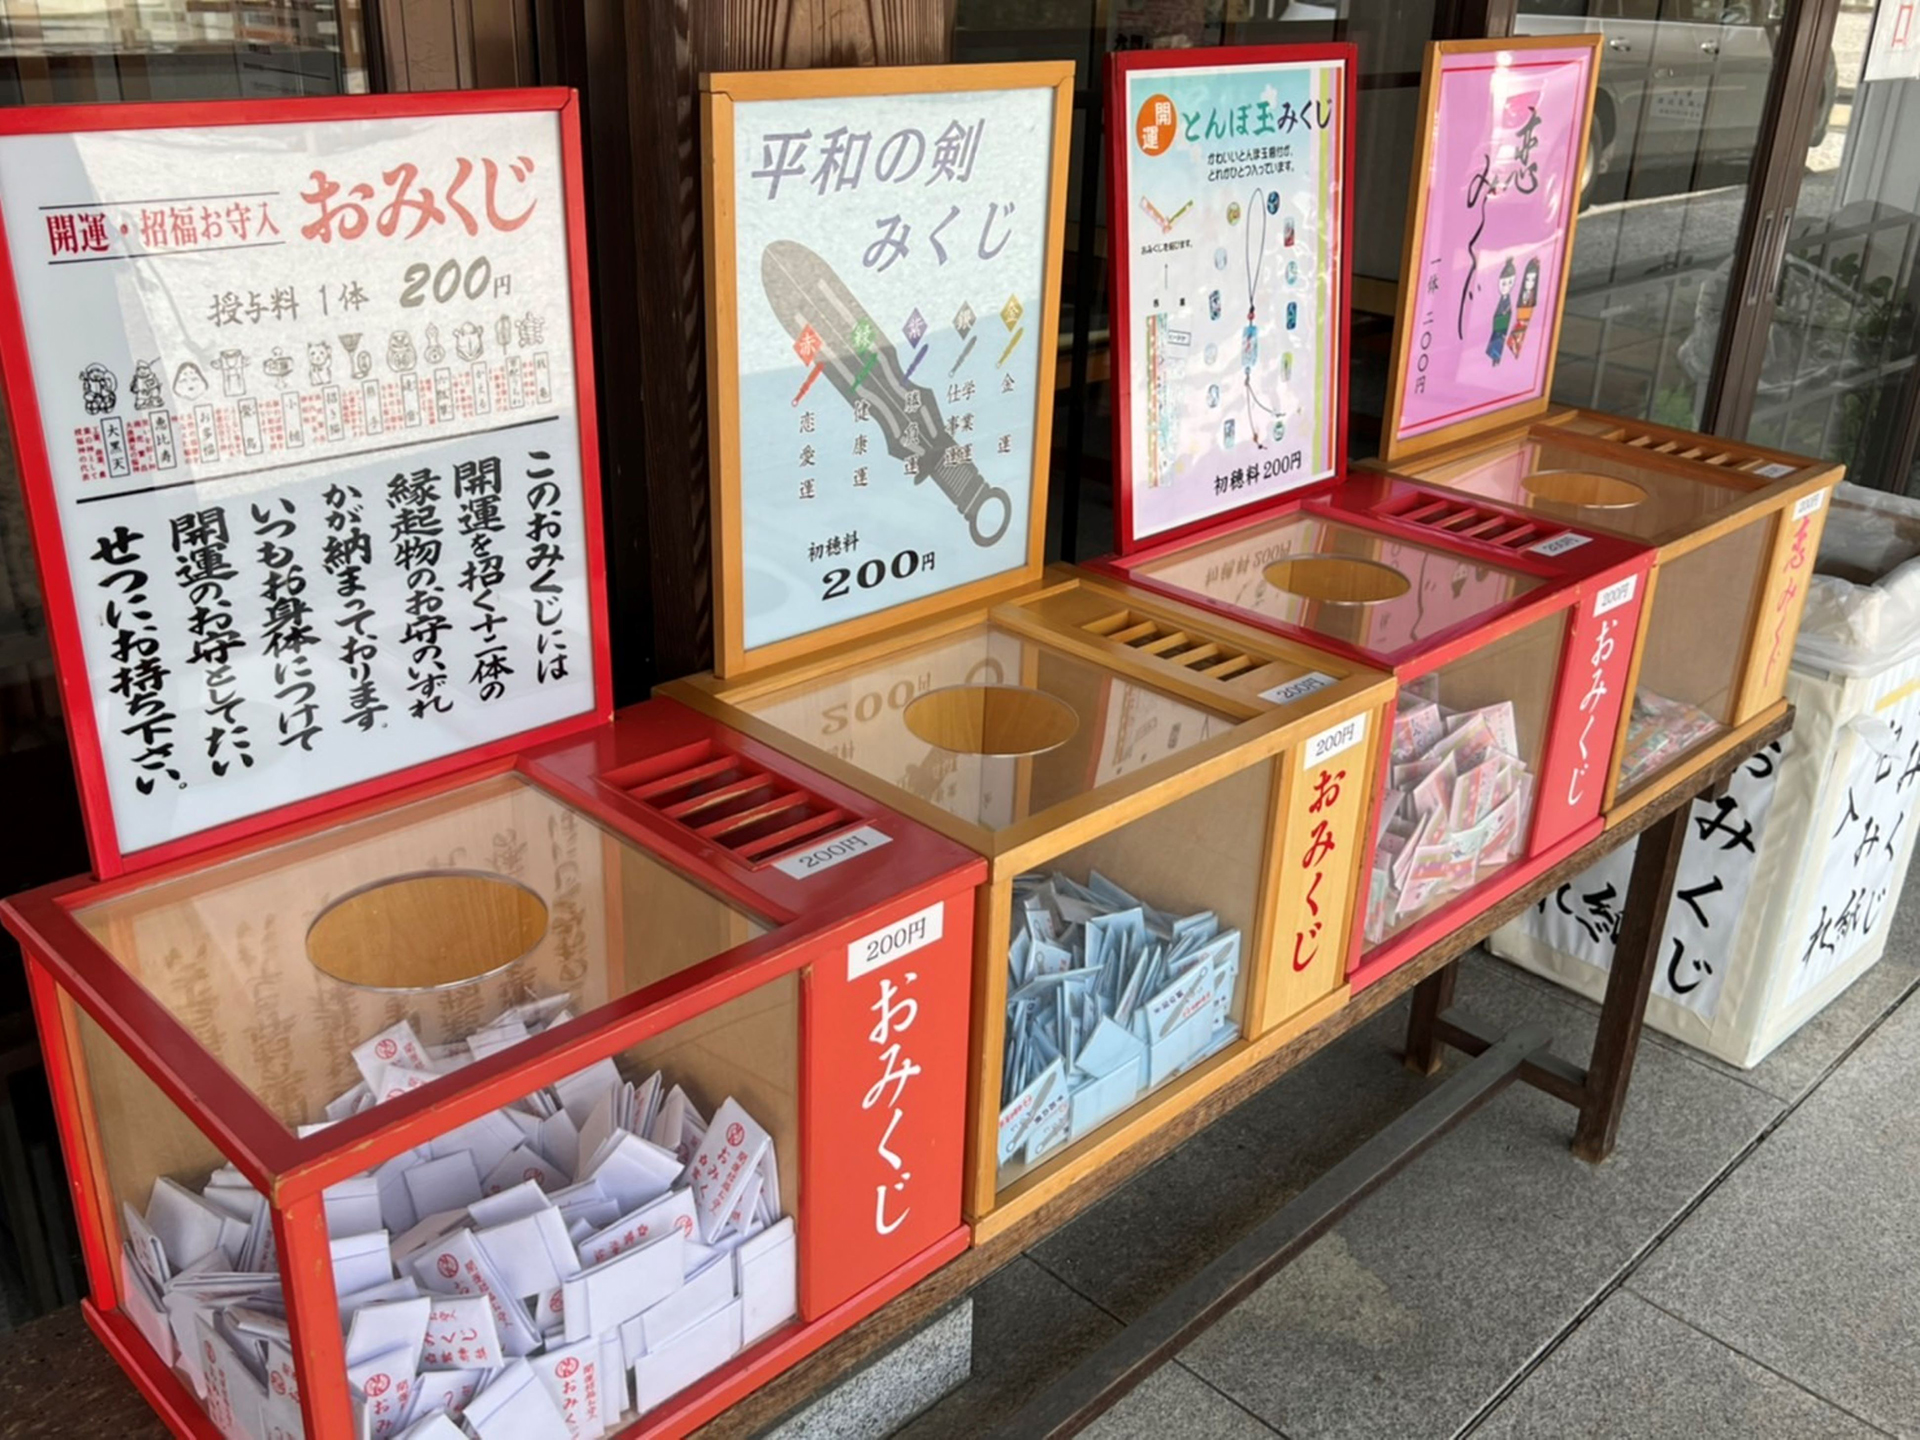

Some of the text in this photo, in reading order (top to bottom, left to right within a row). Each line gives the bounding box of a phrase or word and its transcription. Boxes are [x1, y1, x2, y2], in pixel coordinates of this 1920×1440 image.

[1142, 102, 1171, 150] 開運
[1182, 98, 1332, 142] とんぼ玉みくじ
[751, 118, 985, 200] 平和の剣
[46, 201, 280, 256] 開運・招福お守入
[299, 155, 538, 243] おみくじ
[862, 202, 1014, 272] みくじ
[207, 286, 299, 327] 授与料
[399, 255, 511, 308] 200円
[1004, 302, 1020, 324] 金
[798, 333, 817, 357] 赤
[155, 416, 173, 463] 恵比寿
[200, 412, 216, 458] お多福
[853, 398, 870, 487] 健康運
[997, 373, 1015, 454] 金運
[107, 424, 126, 471] 大黒天
[799, 411, 815, 500] 恋愛運
[1214, 450, 1302, 496] 初穂料200円
[525, 451, 569, 683] このおみくじには
[808, 530, 859, 562] 初穂料
[822, 550, 935, 601] 200円
[386, 468, 454, 719] 縁起物のお守のいずれ
[453, 456, 514, 701] 開運を招く十二体の
[1601, 582, 1631, 608] 200円
[169, 507, 254, 777] 開運のお守としてたい
[251, 498, 322, 751] いつもお身体につけて
[91, 527, 188, 795] せつにお持ち下さい。
[1277, 677, 1325, 699] 200円
[1316, 723, 1355, 757] 200円
[1568, 619, 1618, 806] おみくじ
[800, 835, 868, 868] 200円
[1292, 770, 1346, 974] おみくじ
[866, 917, 926, 962] 200円
[862, 971, 922, 1236] おみくじ
